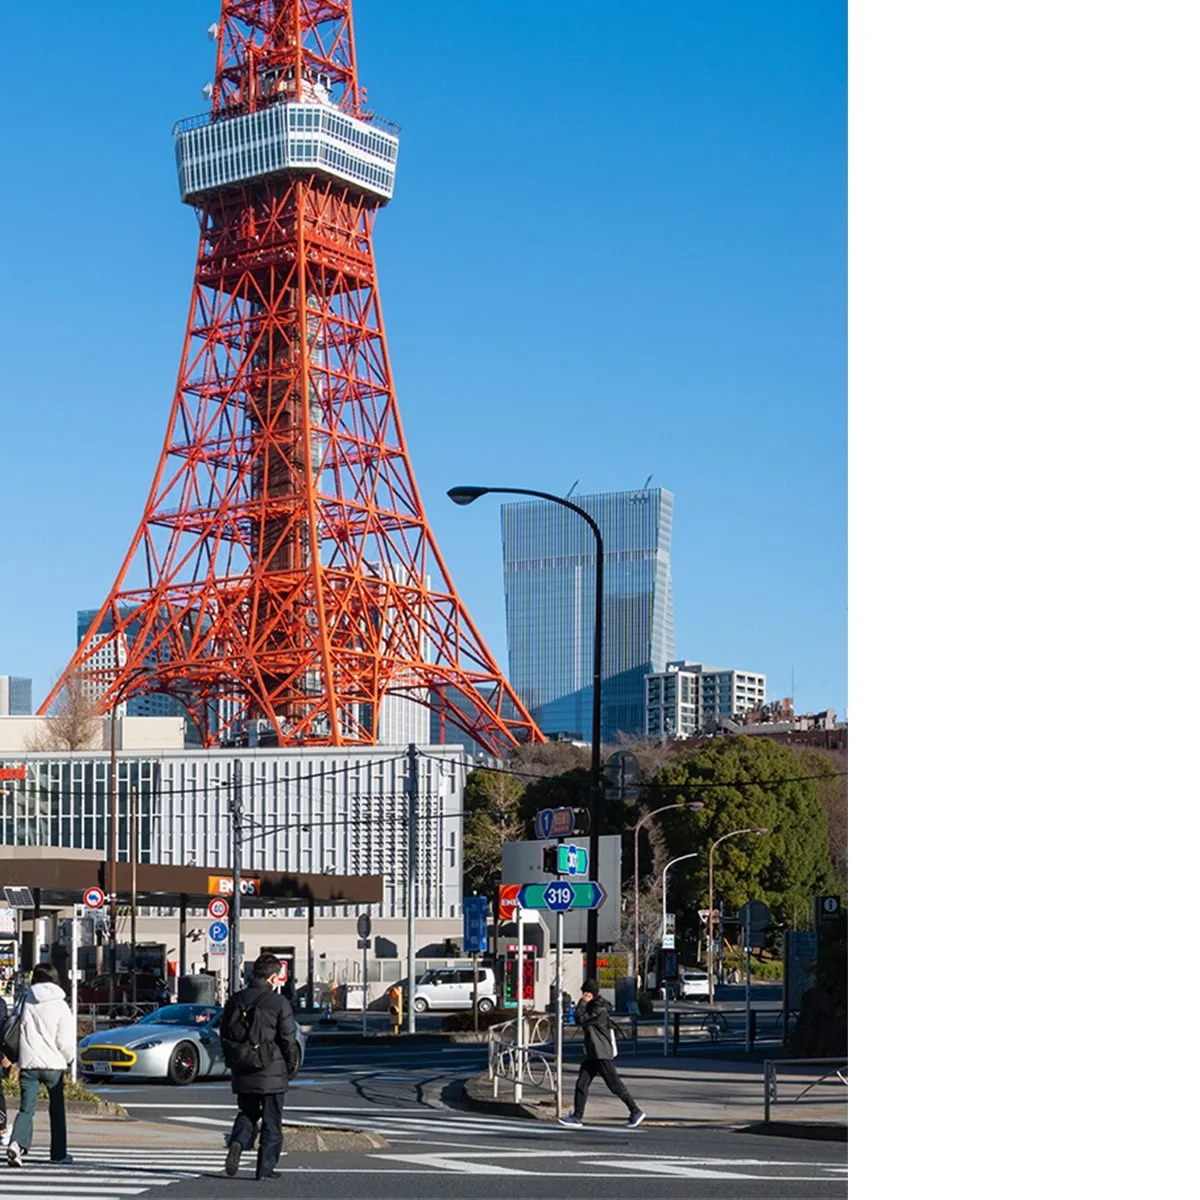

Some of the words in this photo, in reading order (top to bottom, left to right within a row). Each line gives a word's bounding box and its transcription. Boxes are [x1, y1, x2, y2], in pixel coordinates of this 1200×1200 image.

[219, 879, 255, 895] ENOS
[548, 887, 571, 905] 319
[213, 903, 224, 913] 40
